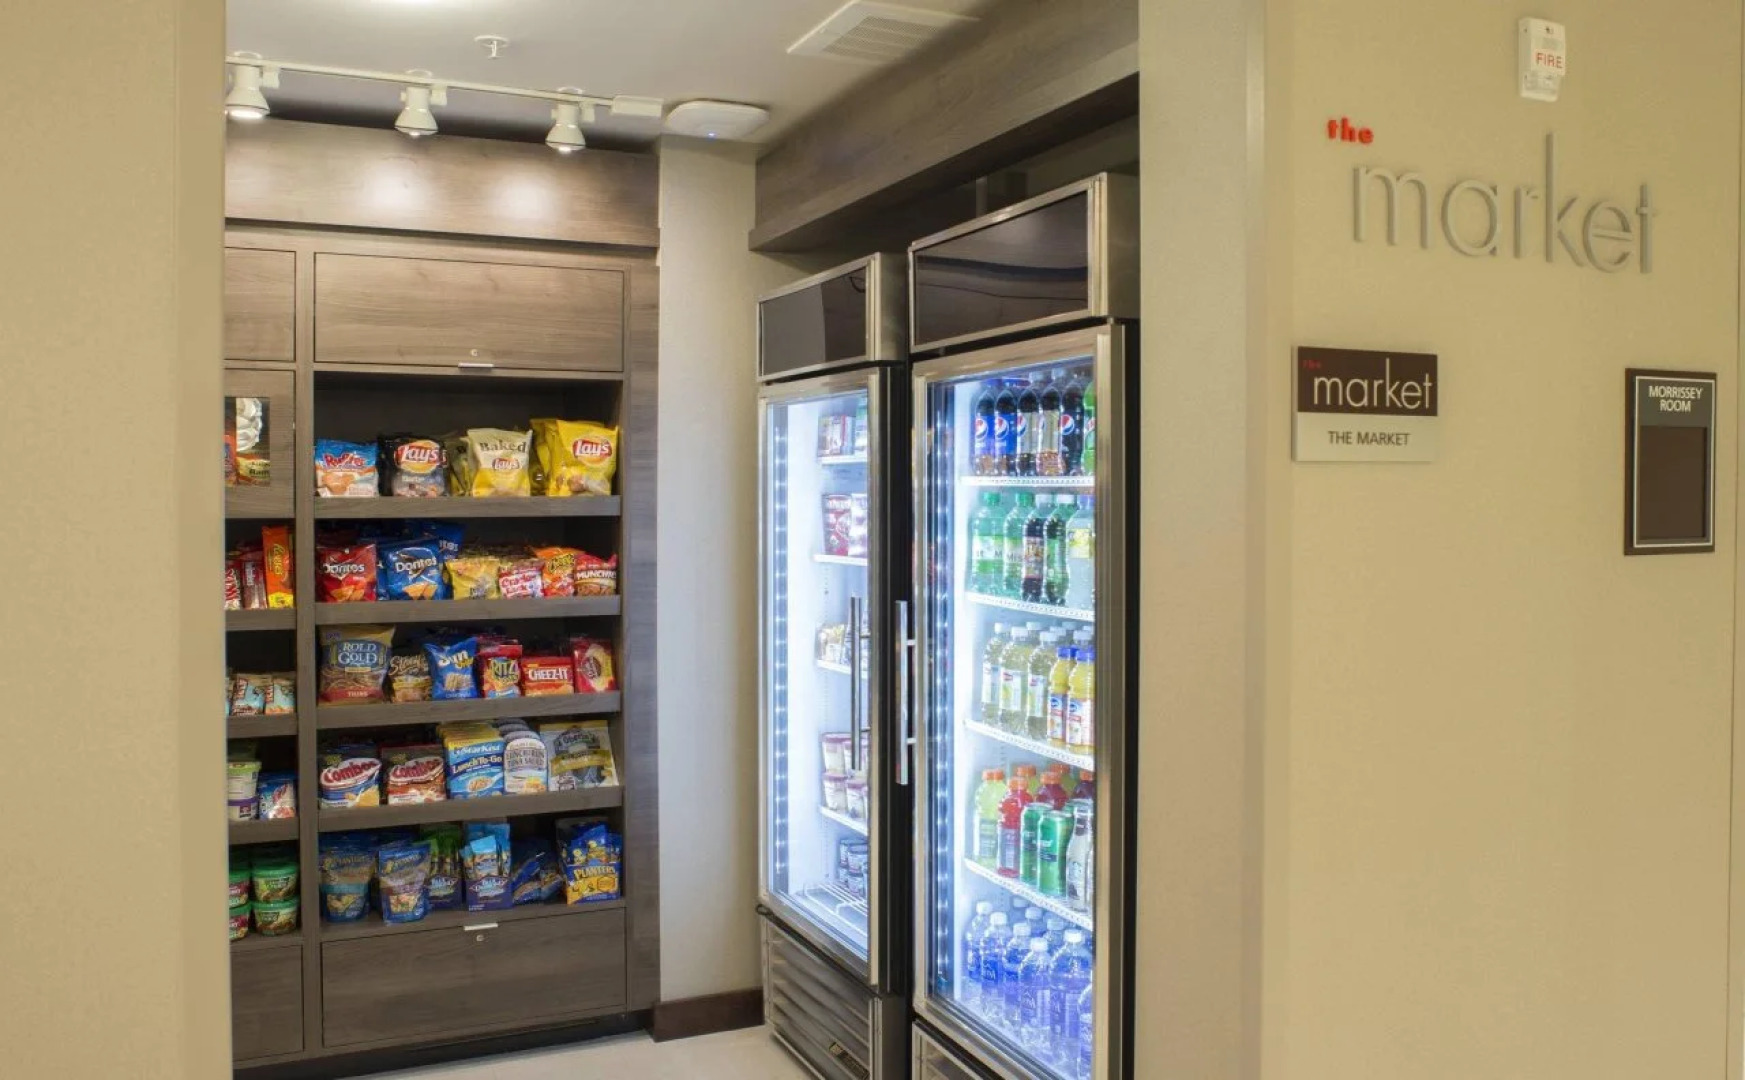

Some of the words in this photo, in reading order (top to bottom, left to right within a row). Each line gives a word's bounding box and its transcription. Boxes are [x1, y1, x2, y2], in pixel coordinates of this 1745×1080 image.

[1536, 52, 1563, 68] FIRE
[1327, 117, 1374, 145] the
[1352, 130, 1658, 274] market
[1313, 357, 1433, 410] market
[1648, 385, 1703, 399] MORRISSEY
[1659, 399, 1692, 413] ROOM
[480, 439, 527, 453] Baked
[1328, 430, 1353, 445] THE
[1357, 431, 1411, 447] MARKET
[395, 556, 437, 573] Doritos
[342, 642, 377, 652] ROLD
[337, 651, 378, 665] GOLD
